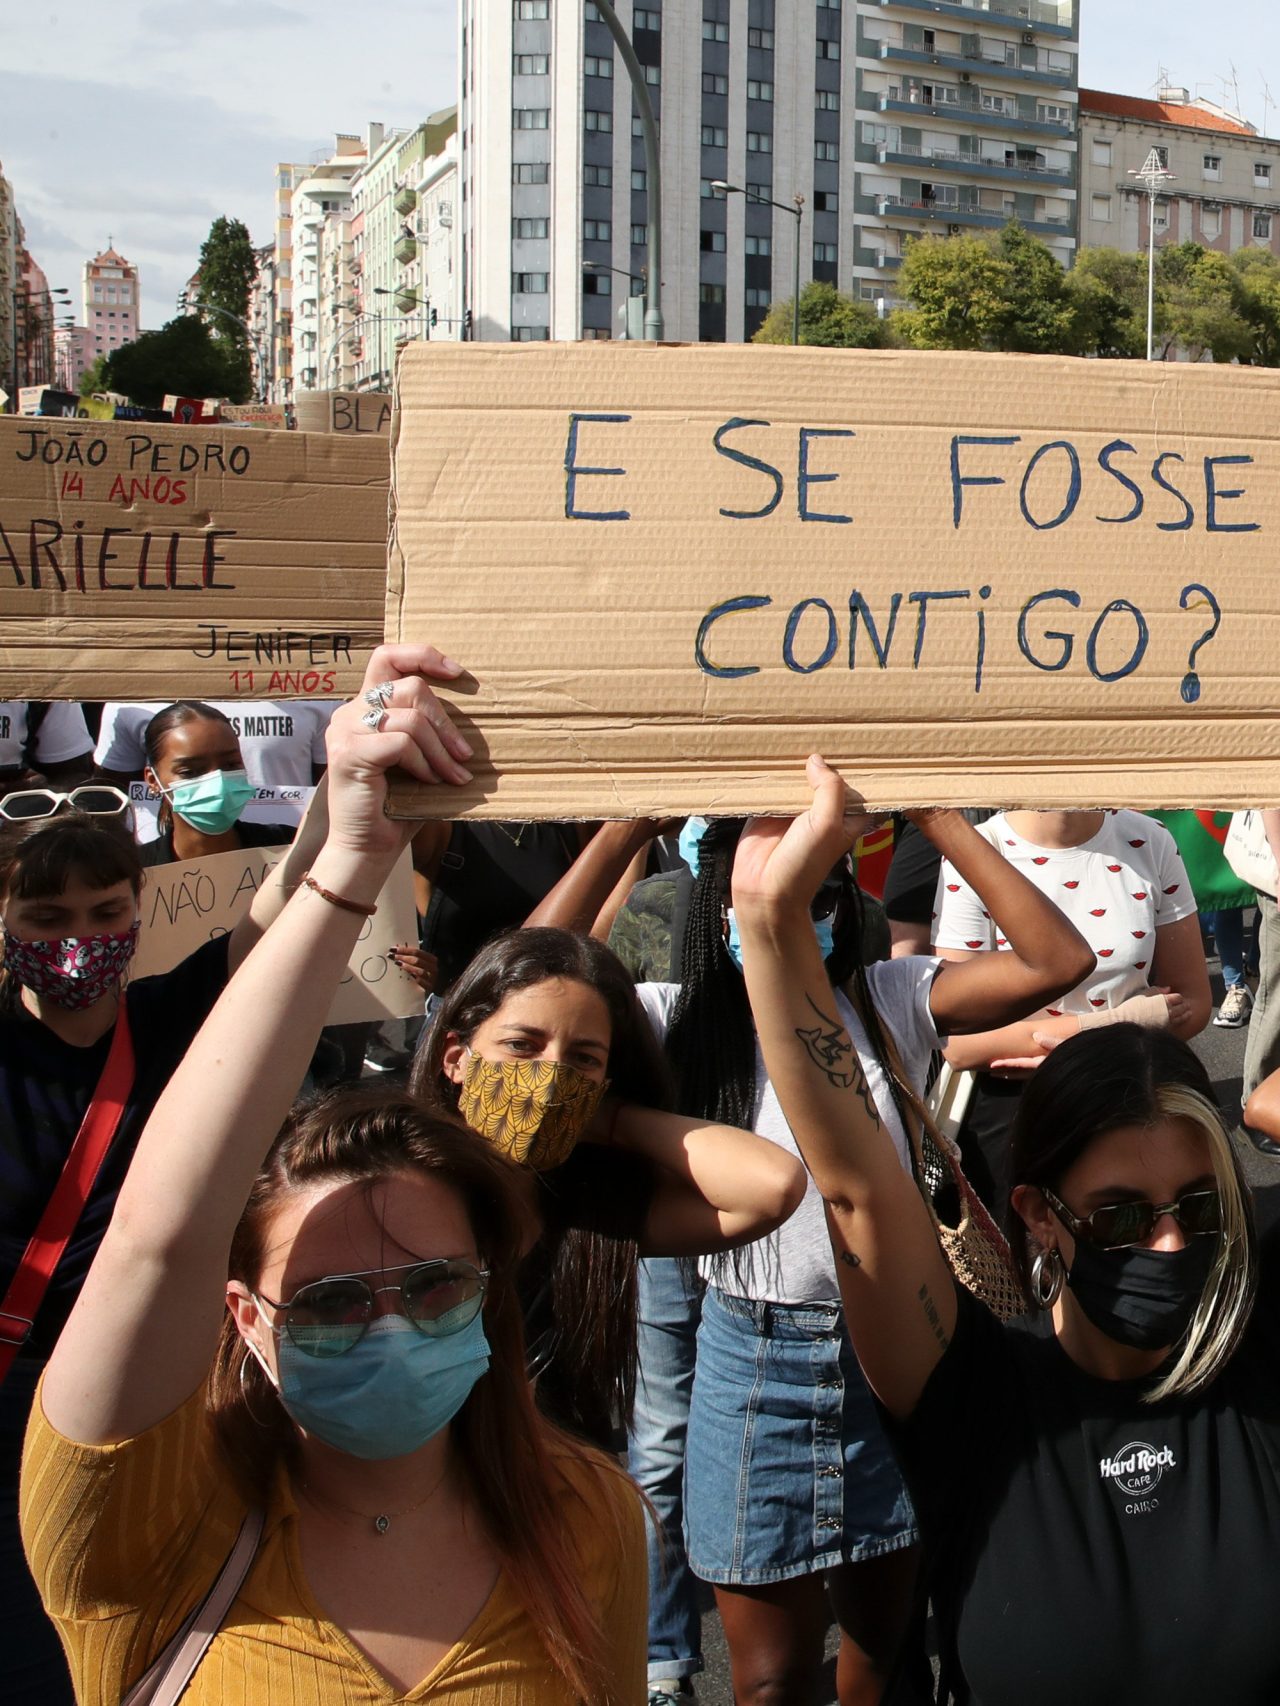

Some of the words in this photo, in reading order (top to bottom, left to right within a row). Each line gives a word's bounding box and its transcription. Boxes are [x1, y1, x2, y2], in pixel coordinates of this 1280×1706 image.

[16, 430, 108, 467] JOÃO
[125, 435, 251, 475] PEDRO
[61, 471, 83, 500] 14
[109, 474, 188, 504] ANOS
[565, 413, 631, 522] E
[712, 417, 855, 525] SE
[951, 433, 1262, 534] FOSSE
[229, 671, 255, 692] 11
[268, 670, 337, 693] ANOS
[244, 715, 293, 737] MATTER
[150, 869, 216, 928] NÃO
[1100, 1453, 1135, 1478] Hard
[1137, 1445, 1176, 1473] Rock
[1125, 1498, 1159, 1514] CAIRO
